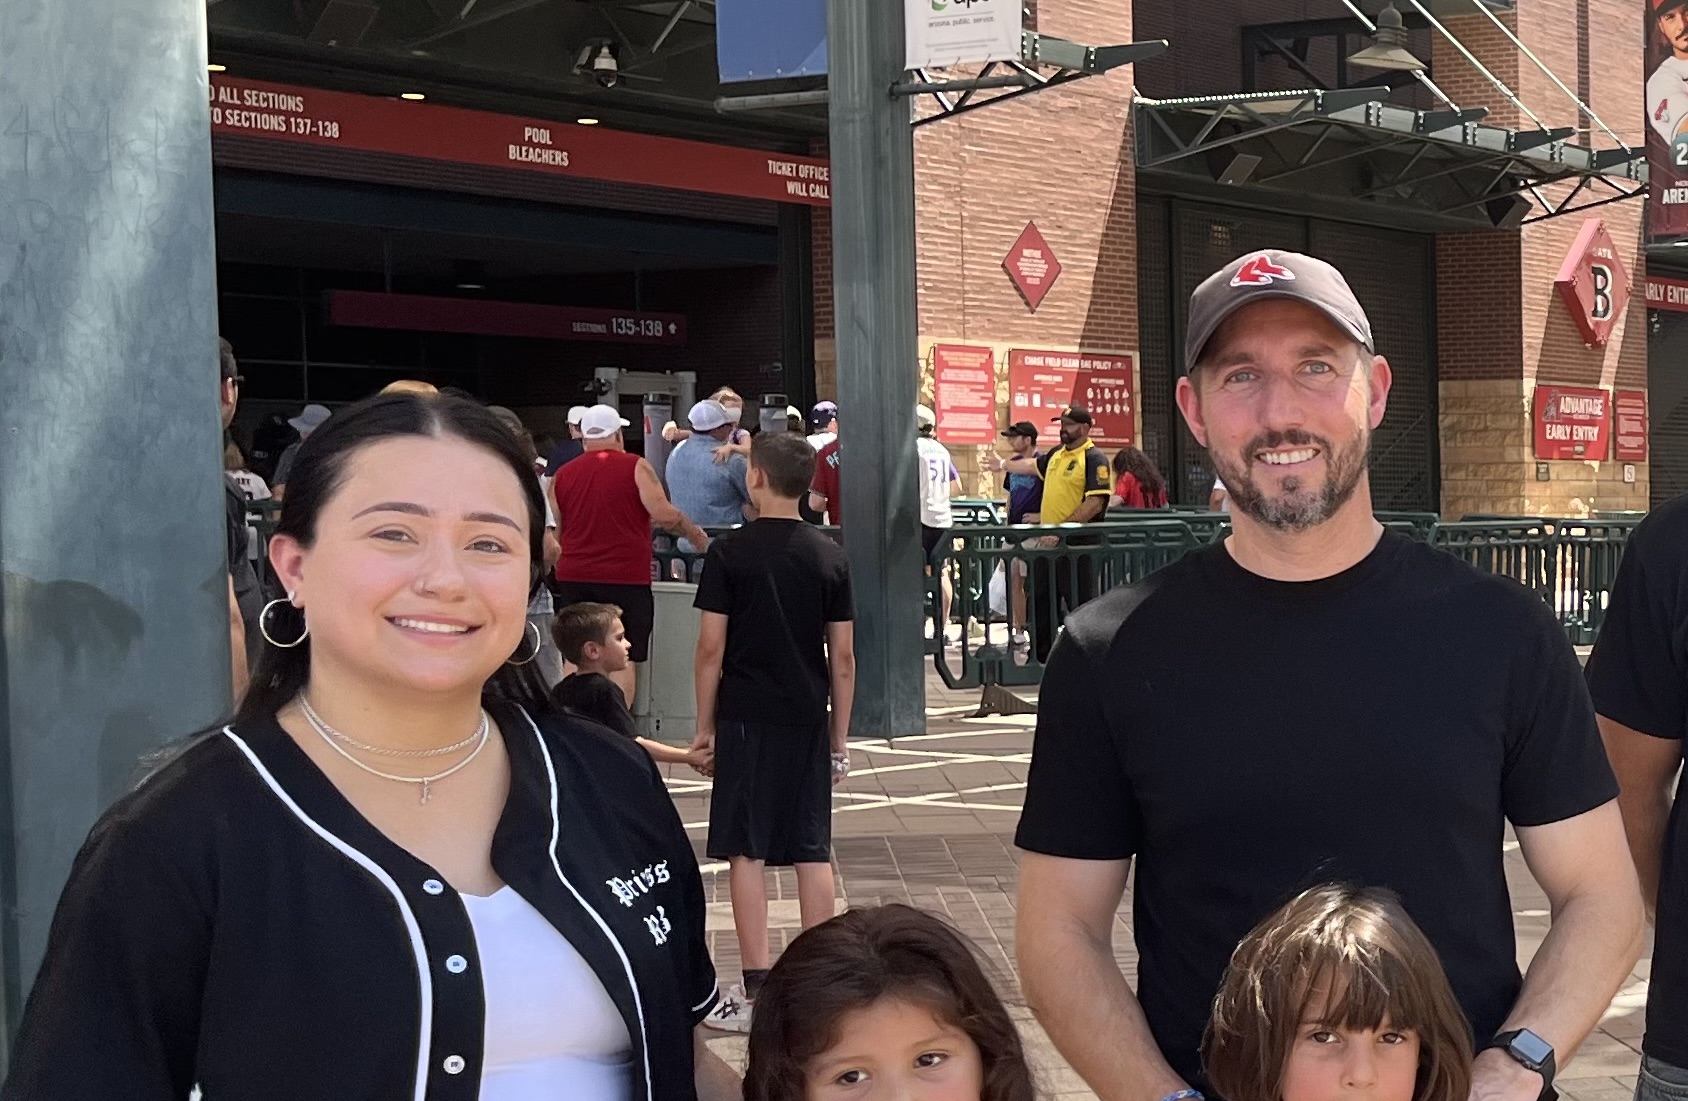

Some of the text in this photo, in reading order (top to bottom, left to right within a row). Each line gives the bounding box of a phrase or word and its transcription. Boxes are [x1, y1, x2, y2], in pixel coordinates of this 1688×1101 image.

[218, 86, 241, 105] ALL
[243, 89, 304, 113] SECTIONS
[225, 110, 287, 133] SECTIONS
[289, 117, 340, 139] 137-138
[524, 126, 553, 145] POOL
[508, 144, 570, 167] BLEACHERS
[767, 159, 829, 181] TICKET OFFICE
[786, 180, 830, 199] WILL CALL
[1591, 263, 1613, 321] B
[611, 316, 663, 337] 135-138
[1092, 360, 1112, 370] POLICY
[1559, 396, 1604, 416] ADVANTAGE
[1545, 424, 1600, 442] EARLY ENTRY
[929, 458, 947, 484] 51
